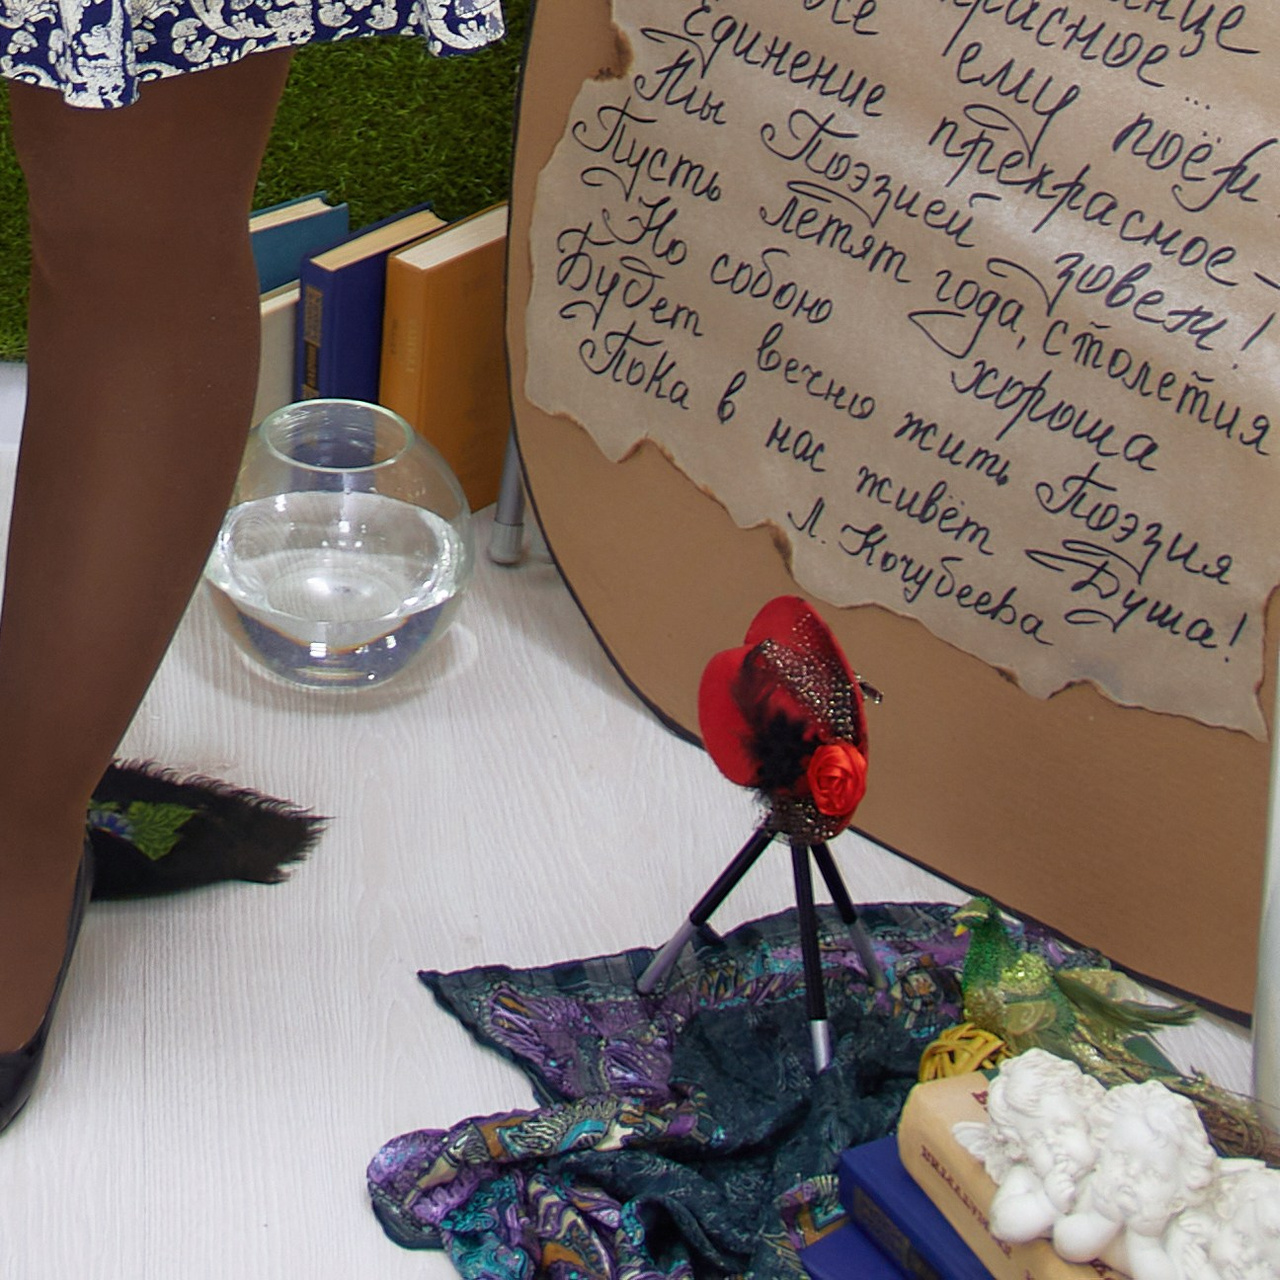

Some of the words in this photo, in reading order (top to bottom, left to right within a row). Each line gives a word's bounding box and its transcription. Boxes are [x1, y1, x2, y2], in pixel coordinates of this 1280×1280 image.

[634, 49, 728, 126] Мы
[760, 107, 1001, 249] Поэзией
[956, 42, 1081, 168] ему
[572, 98, 722, 202] Пусть
[760, 197, 912, 285] летят
[1042, 317, 1274, 458] столетия
[602, 195, 687, 267] Но
[710, 247, 835, 325] собою
[950, 358, 1160, 473] хороша
[557, 227, 704, 337] Будет
[756, 323, 876, 421] вечно
[894, 411, 1010, 487] жить
[1035, 462, 1232, 586] Поэзия
[579, 329, 691, 411] Пока
[717, 371, 748, 425] в
[765, 422, 827, 473] нас
